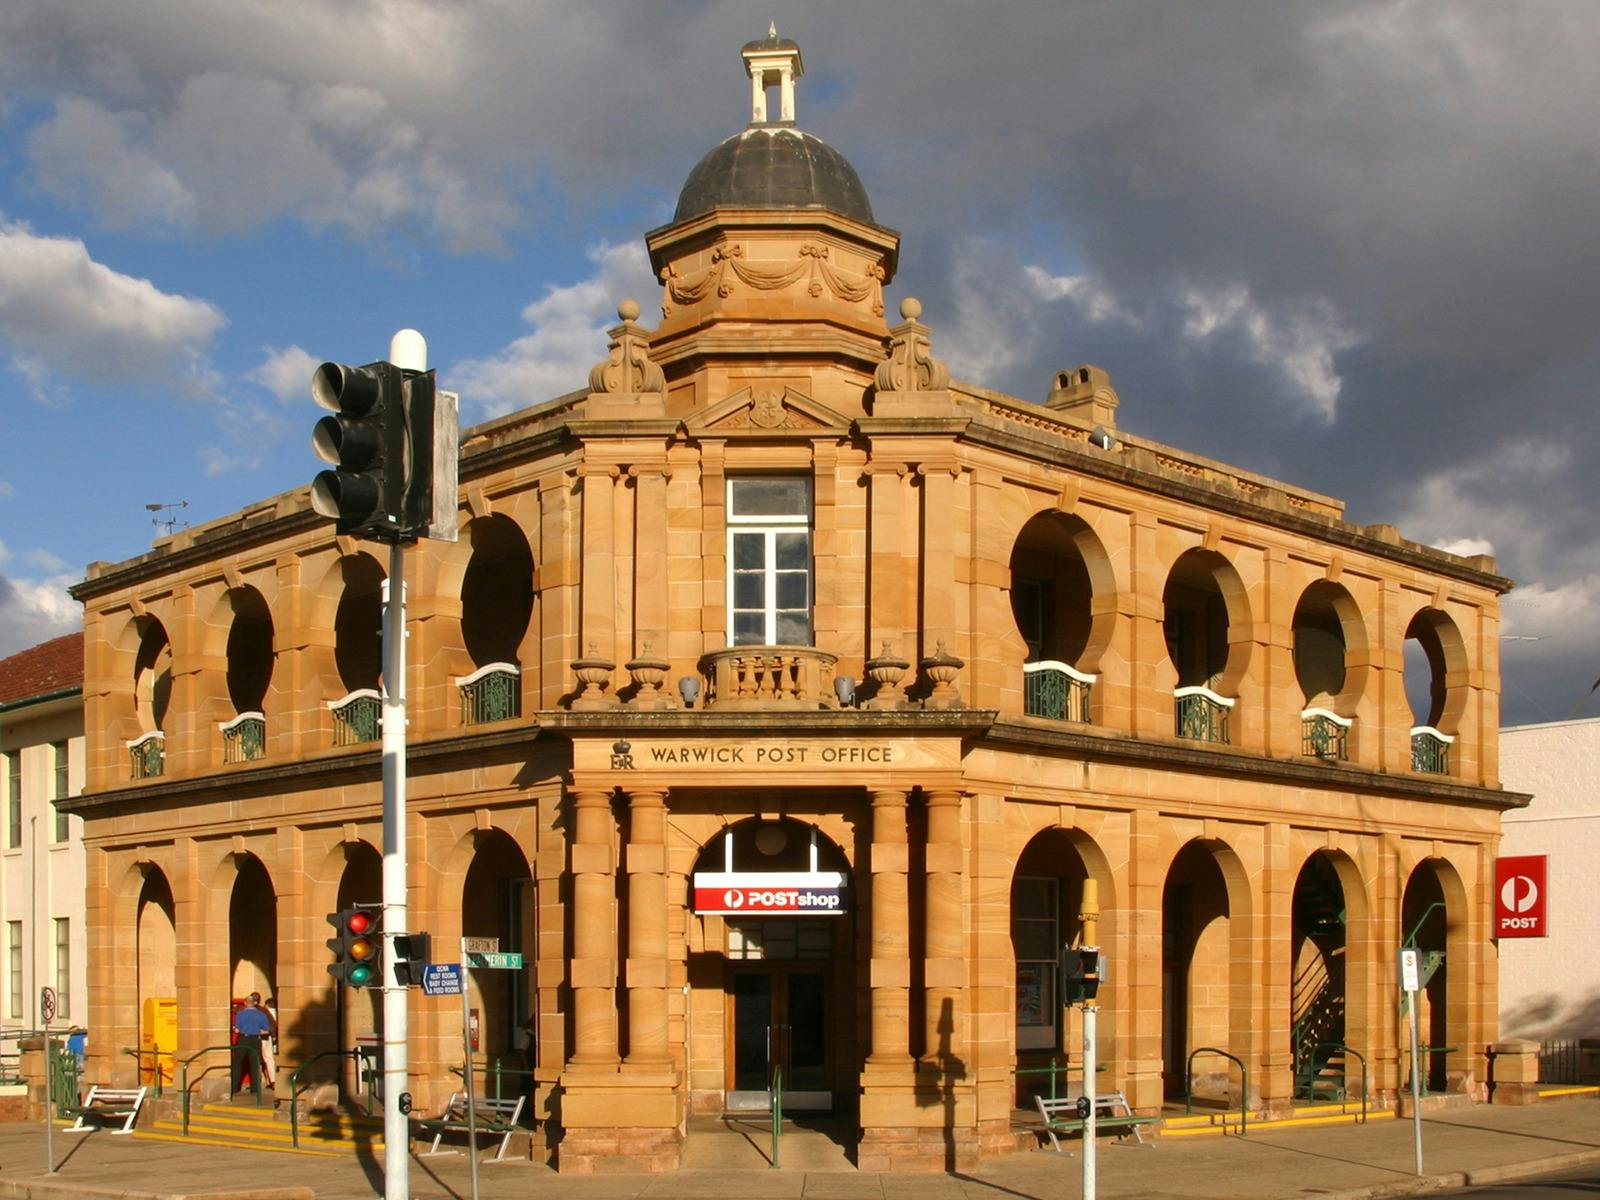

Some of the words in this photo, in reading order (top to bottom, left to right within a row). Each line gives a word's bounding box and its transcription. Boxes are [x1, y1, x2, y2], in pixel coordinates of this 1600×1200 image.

[651, 747, 744, 763] WARWICK
[756, 747, 808, 763] POST
[821, 747, 892, 763] OFFICE
[1501, 917, 1538, 929] POST
[511, 955, 519, 968] ST
